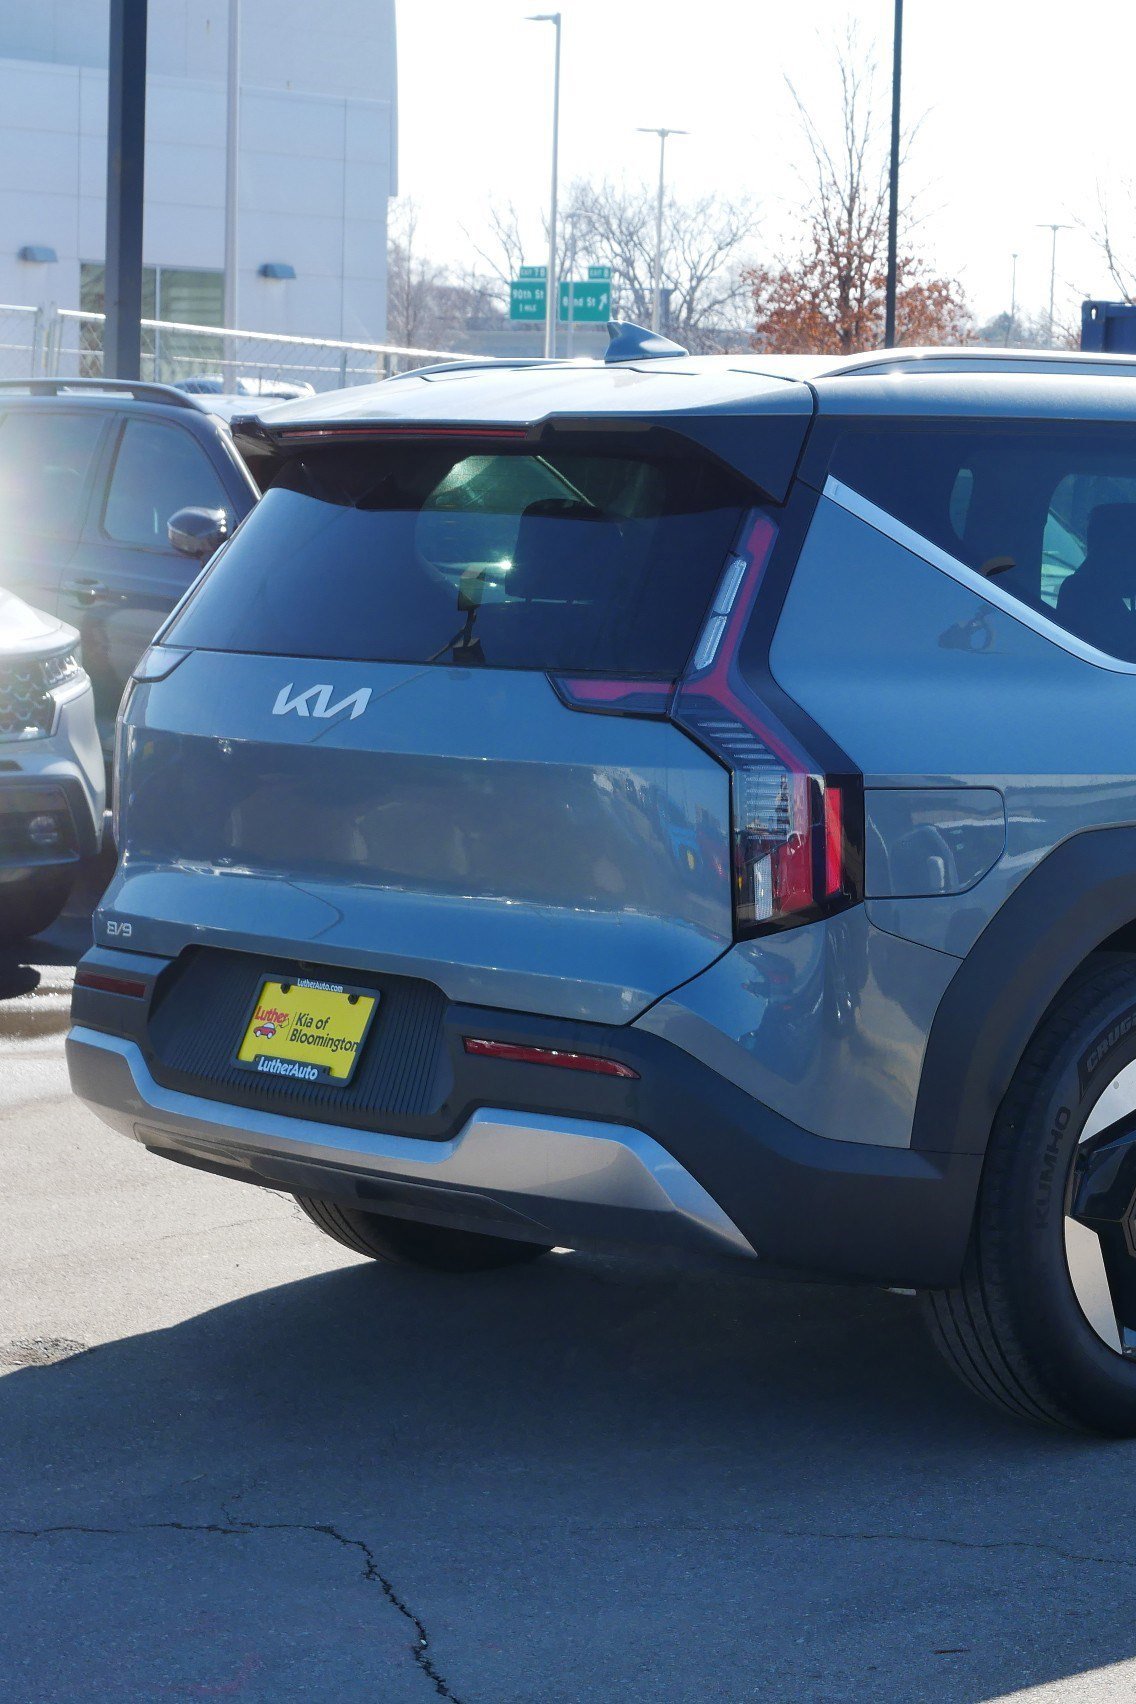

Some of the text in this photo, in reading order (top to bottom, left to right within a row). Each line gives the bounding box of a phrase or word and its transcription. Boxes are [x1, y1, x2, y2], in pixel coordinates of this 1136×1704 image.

[535, 289, 544, 299] St
[562, 296, 583, 307] 8nd
[272, 682, 373, 720] KIA
[107, 920, 132, 937] EV9
[297, 978, 344, 993] LutherAuto.com
[254, 1005, 289, 1024] Luther
[295, 1012, 331, 1031] Kia of
[289, 1029, 359, 1053] Bloomington
[257, 1056, 319, 1081] LutherAuto
